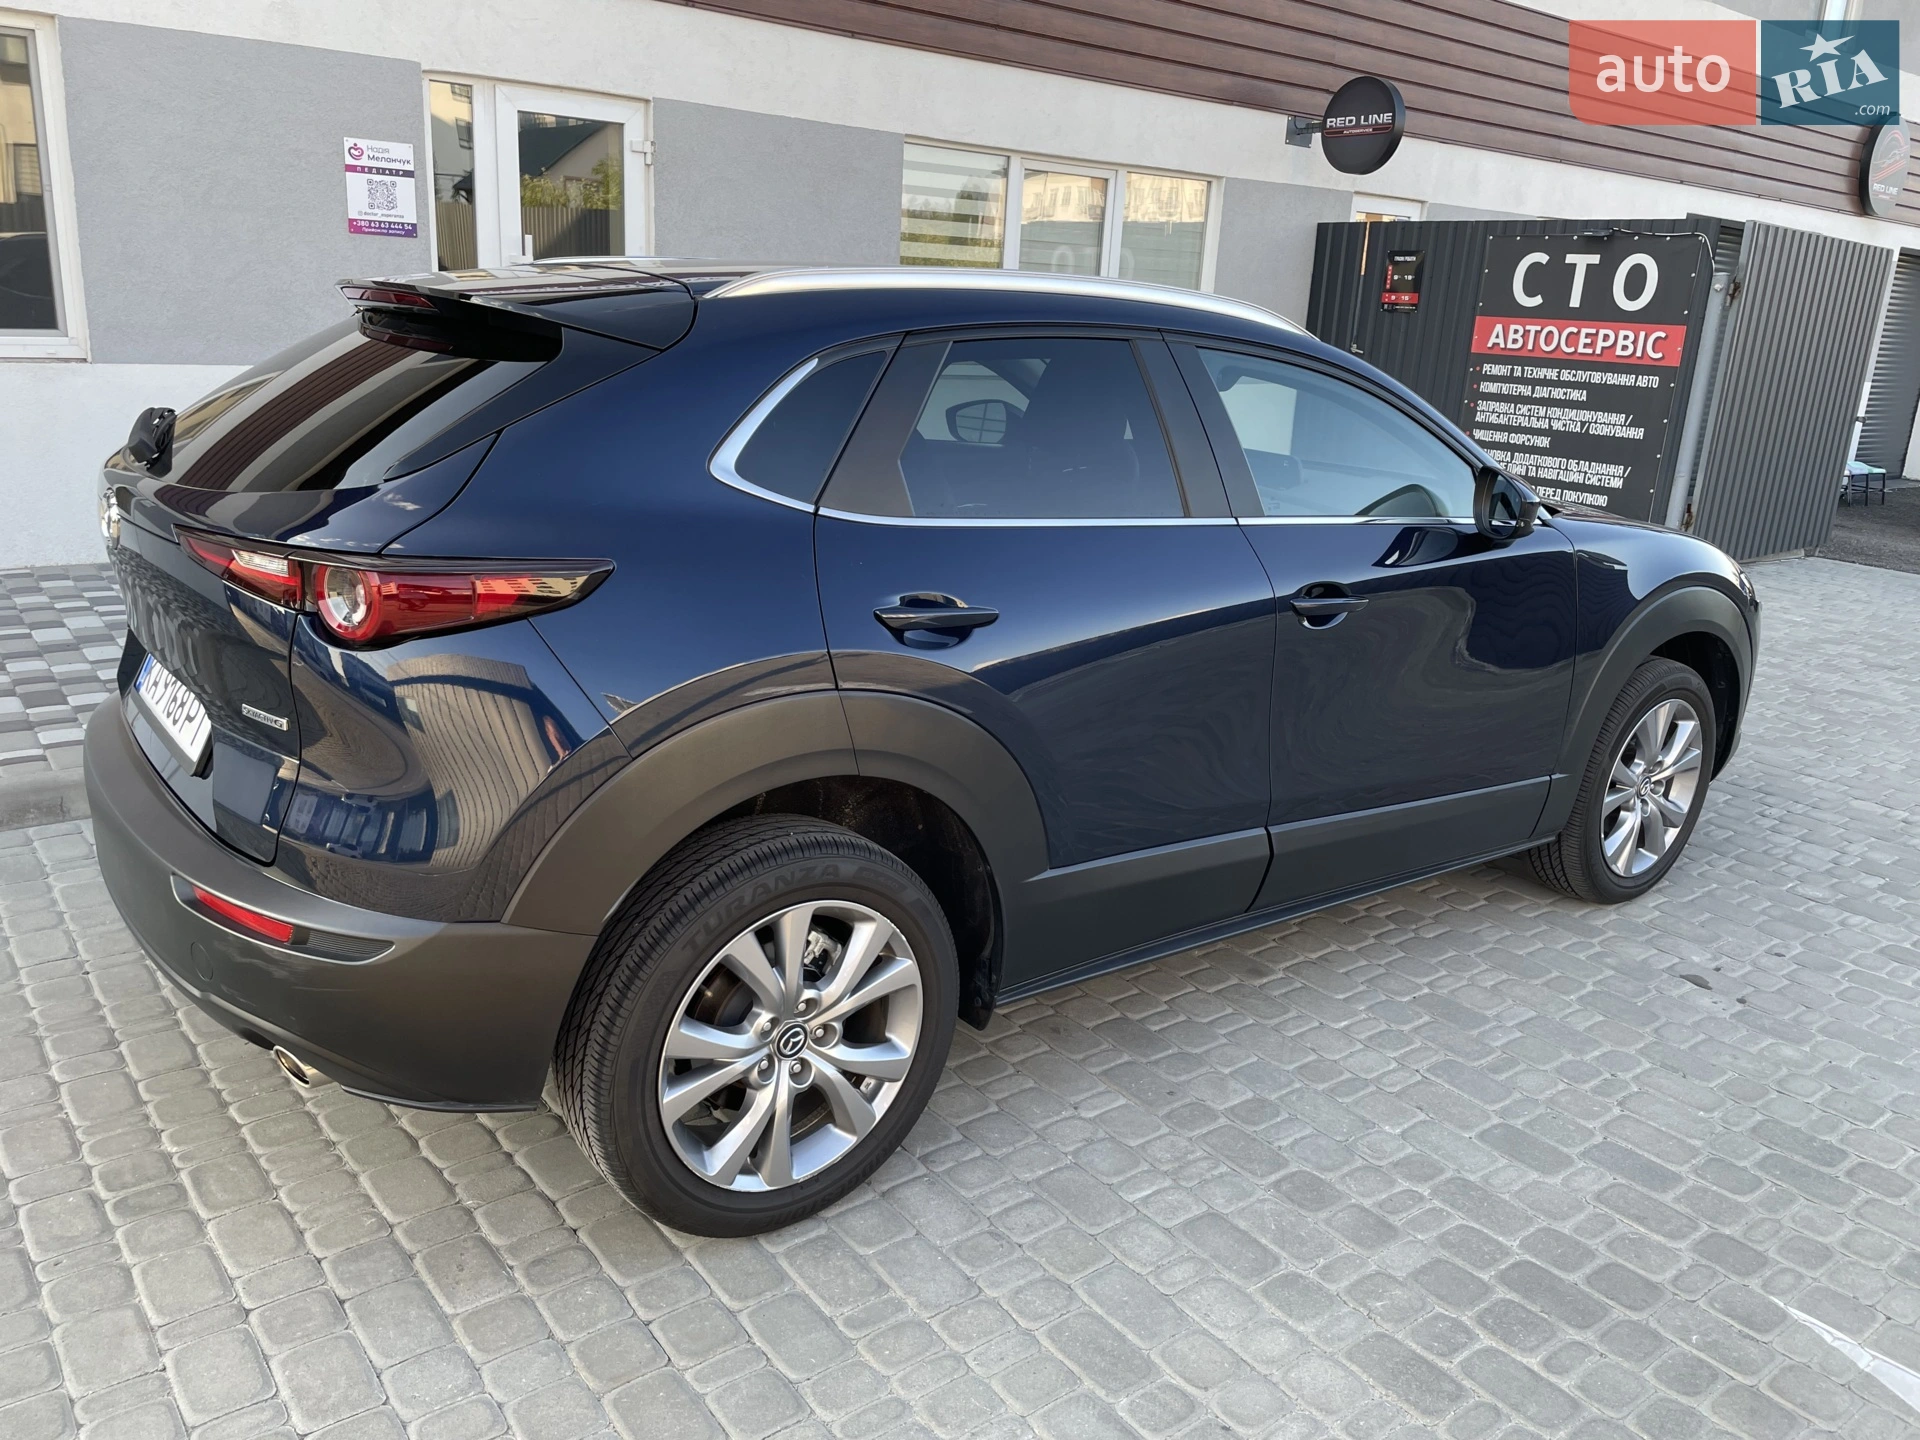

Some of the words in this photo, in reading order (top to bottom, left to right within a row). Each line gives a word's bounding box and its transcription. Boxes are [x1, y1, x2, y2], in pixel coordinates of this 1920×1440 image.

[1326, 116, 1356, 128] RED
[1360, 112, 1393, 125] LINE
[366, 145, 390, 154] Надія
[367, 154, 412, 166] Меланчук
[357, 167, 404, 175] ПЕДІАТР
[1873, 183, 1885, 192] RED
[1886, 186, 1898, 195] LINE
[1512, 252, 1659, 311] СТО
[1488, 324, 1666, 359] АВТОСЕРВІС
[1482, 363, 1511, 377] РЕМОНТ
[1513, 365, 1522, 377] ТА
[1523, 366, 1560, 381] ТЕХНІЧНЕ
[1560, 371, 1635, 387] ОБСЛУГОВУВАННЯ
[1636, 376, 1659, 388] АВТО
[1533, 386, 1587, 401] ДІАГНОСТИКА
[1476, 400, 1515, 415] ЗАПРАВКА
[1515, 404, 1546, 417] СИСТЕМ
[1547, 406, 1626, 425] КОНДИЦІОНУВАННЯ
[1475, 412, 1549, 430] АНТИБАКТЕРІАЛЬНА
[1550, 418, 1581, 433] ЧИСТКА
[1589, 423, 1645, 440] ОЗОНУВАННЯ
[1472, 428, 1508, 443] ЧИЩЕННЯ
[1508, 432, 1551, 449] ФОРСУНОК
[1512, 452, 1567, 470] ДОДАТКОВОГО
[1568, 459, 1624, 477] ОБЛАДНАННЯ
[1527, 466, 1536, 477] ТА
[1537, 468, 1585, 484] НАВІГАЦІЙНІ
[1585, 474, 1624, 489] СИСТЕМИ
[1536, 485, 1561, 500] ПЕРЕД
[1562, 489, 1608, 507] ПОКУПКОЮ
[681, 863, 842, 952] TURANZA
